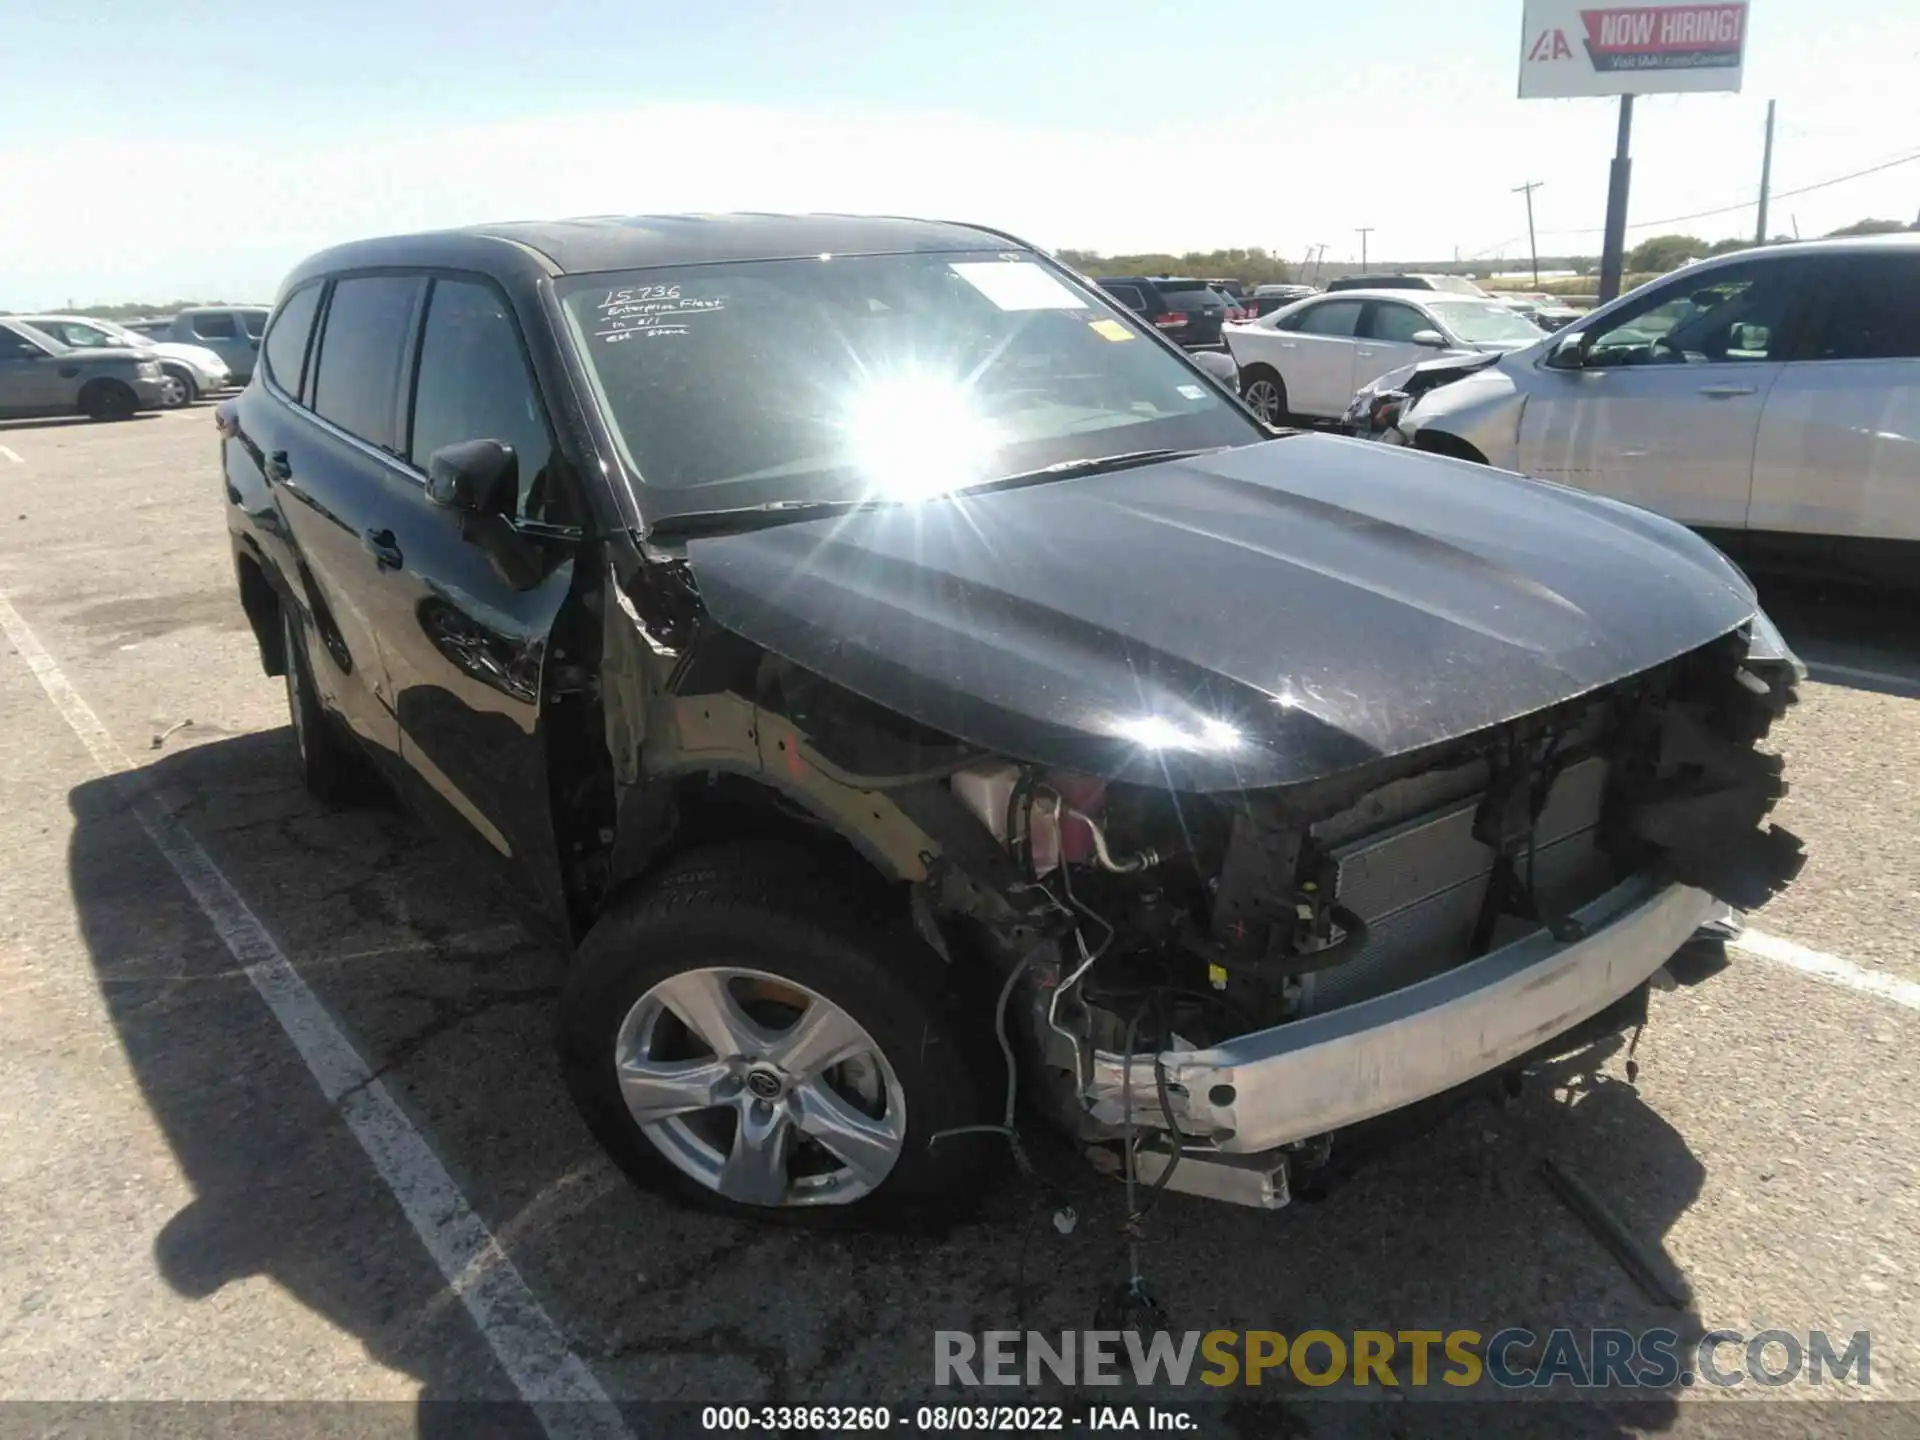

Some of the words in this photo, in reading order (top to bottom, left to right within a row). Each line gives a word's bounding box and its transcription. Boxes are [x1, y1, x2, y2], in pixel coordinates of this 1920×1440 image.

[1601, 14, 1656, 45] NOW
[1660, 8, 1741, 43] HIRING!
[1611, 55, 1635, 68] Visit
